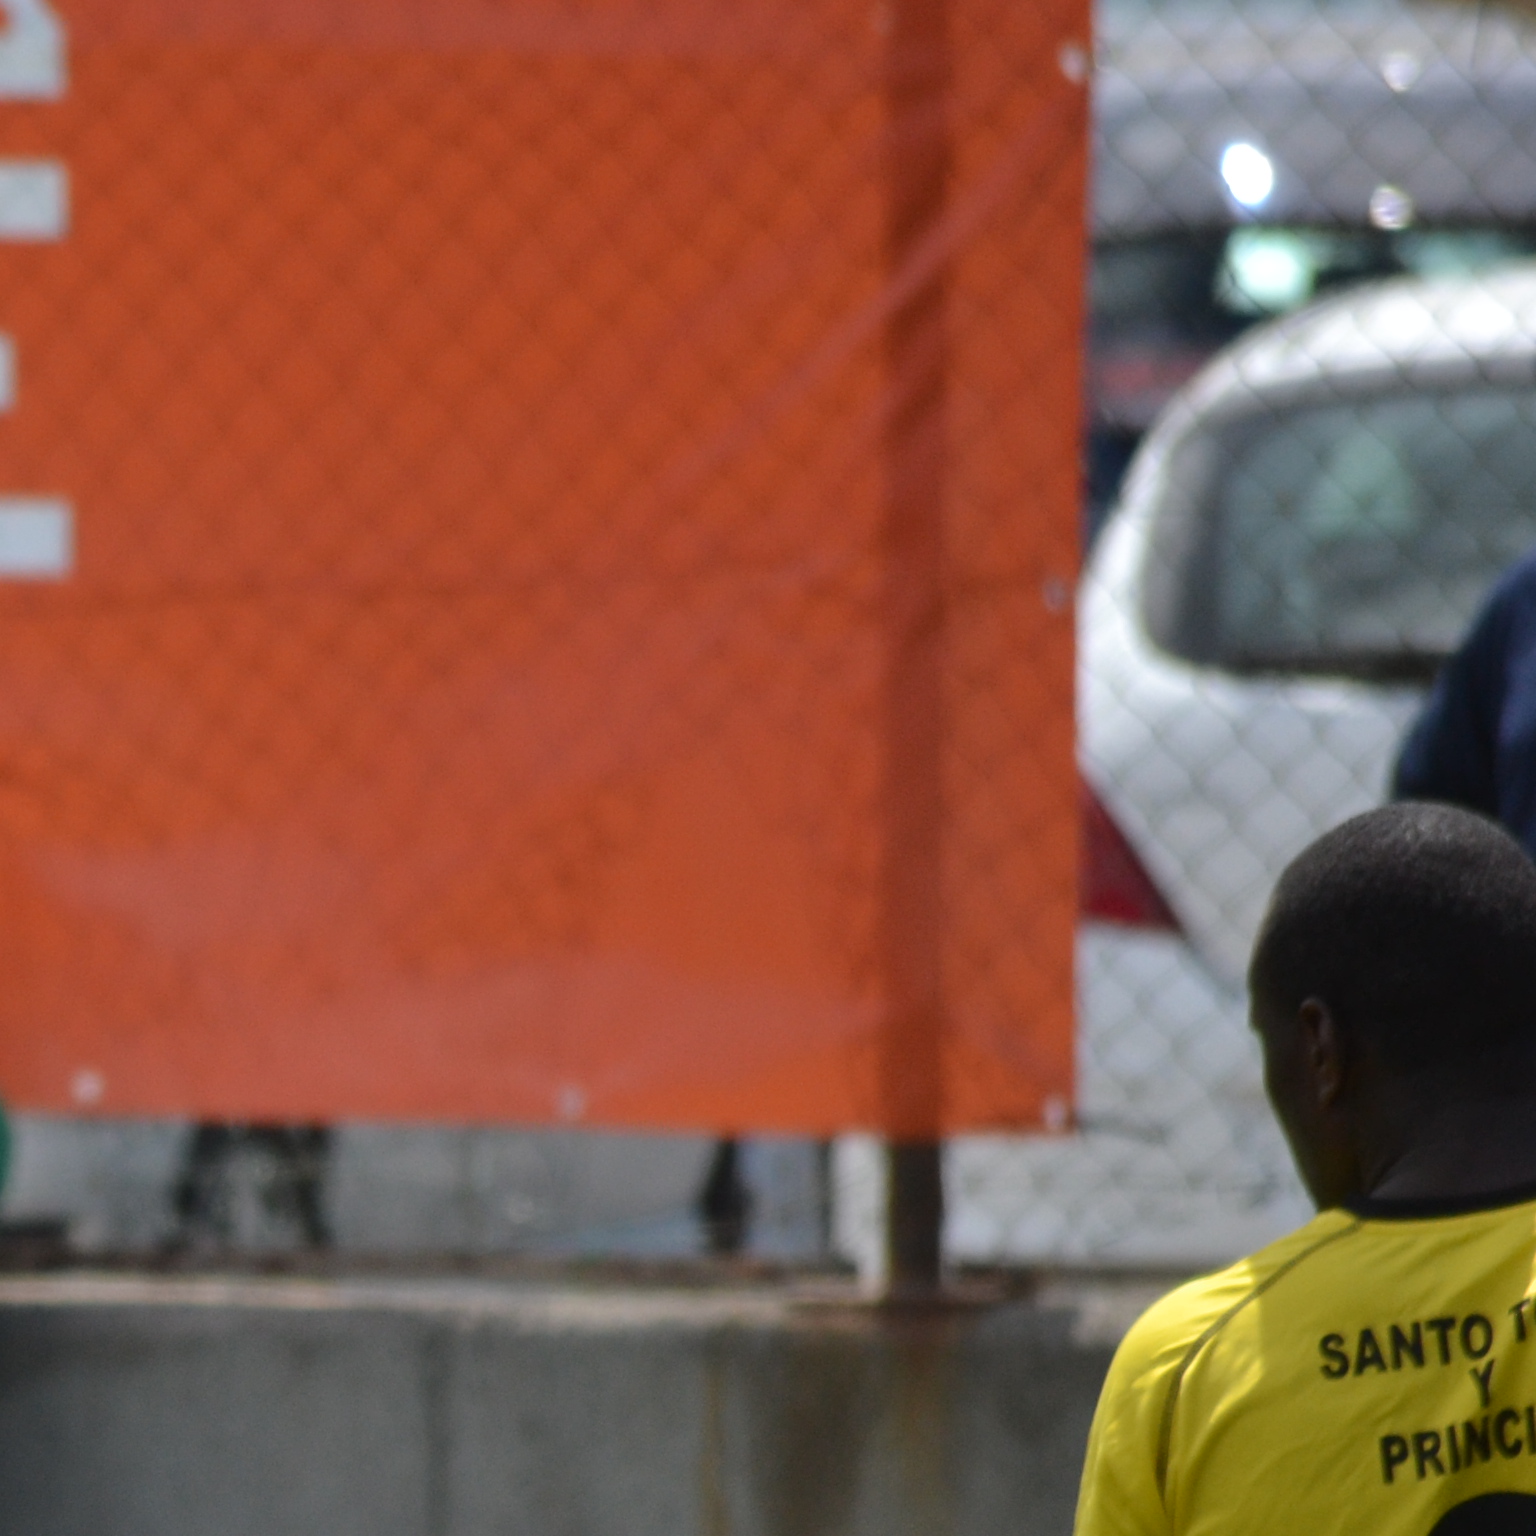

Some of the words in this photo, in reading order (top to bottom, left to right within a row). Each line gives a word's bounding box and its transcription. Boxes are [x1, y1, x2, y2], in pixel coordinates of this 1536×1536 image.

[1317, 1313, 1495, 1380] SANTO
[1507, 1297, 1536, 1344] T
[1468, 1358, 1496, 1409] Y
